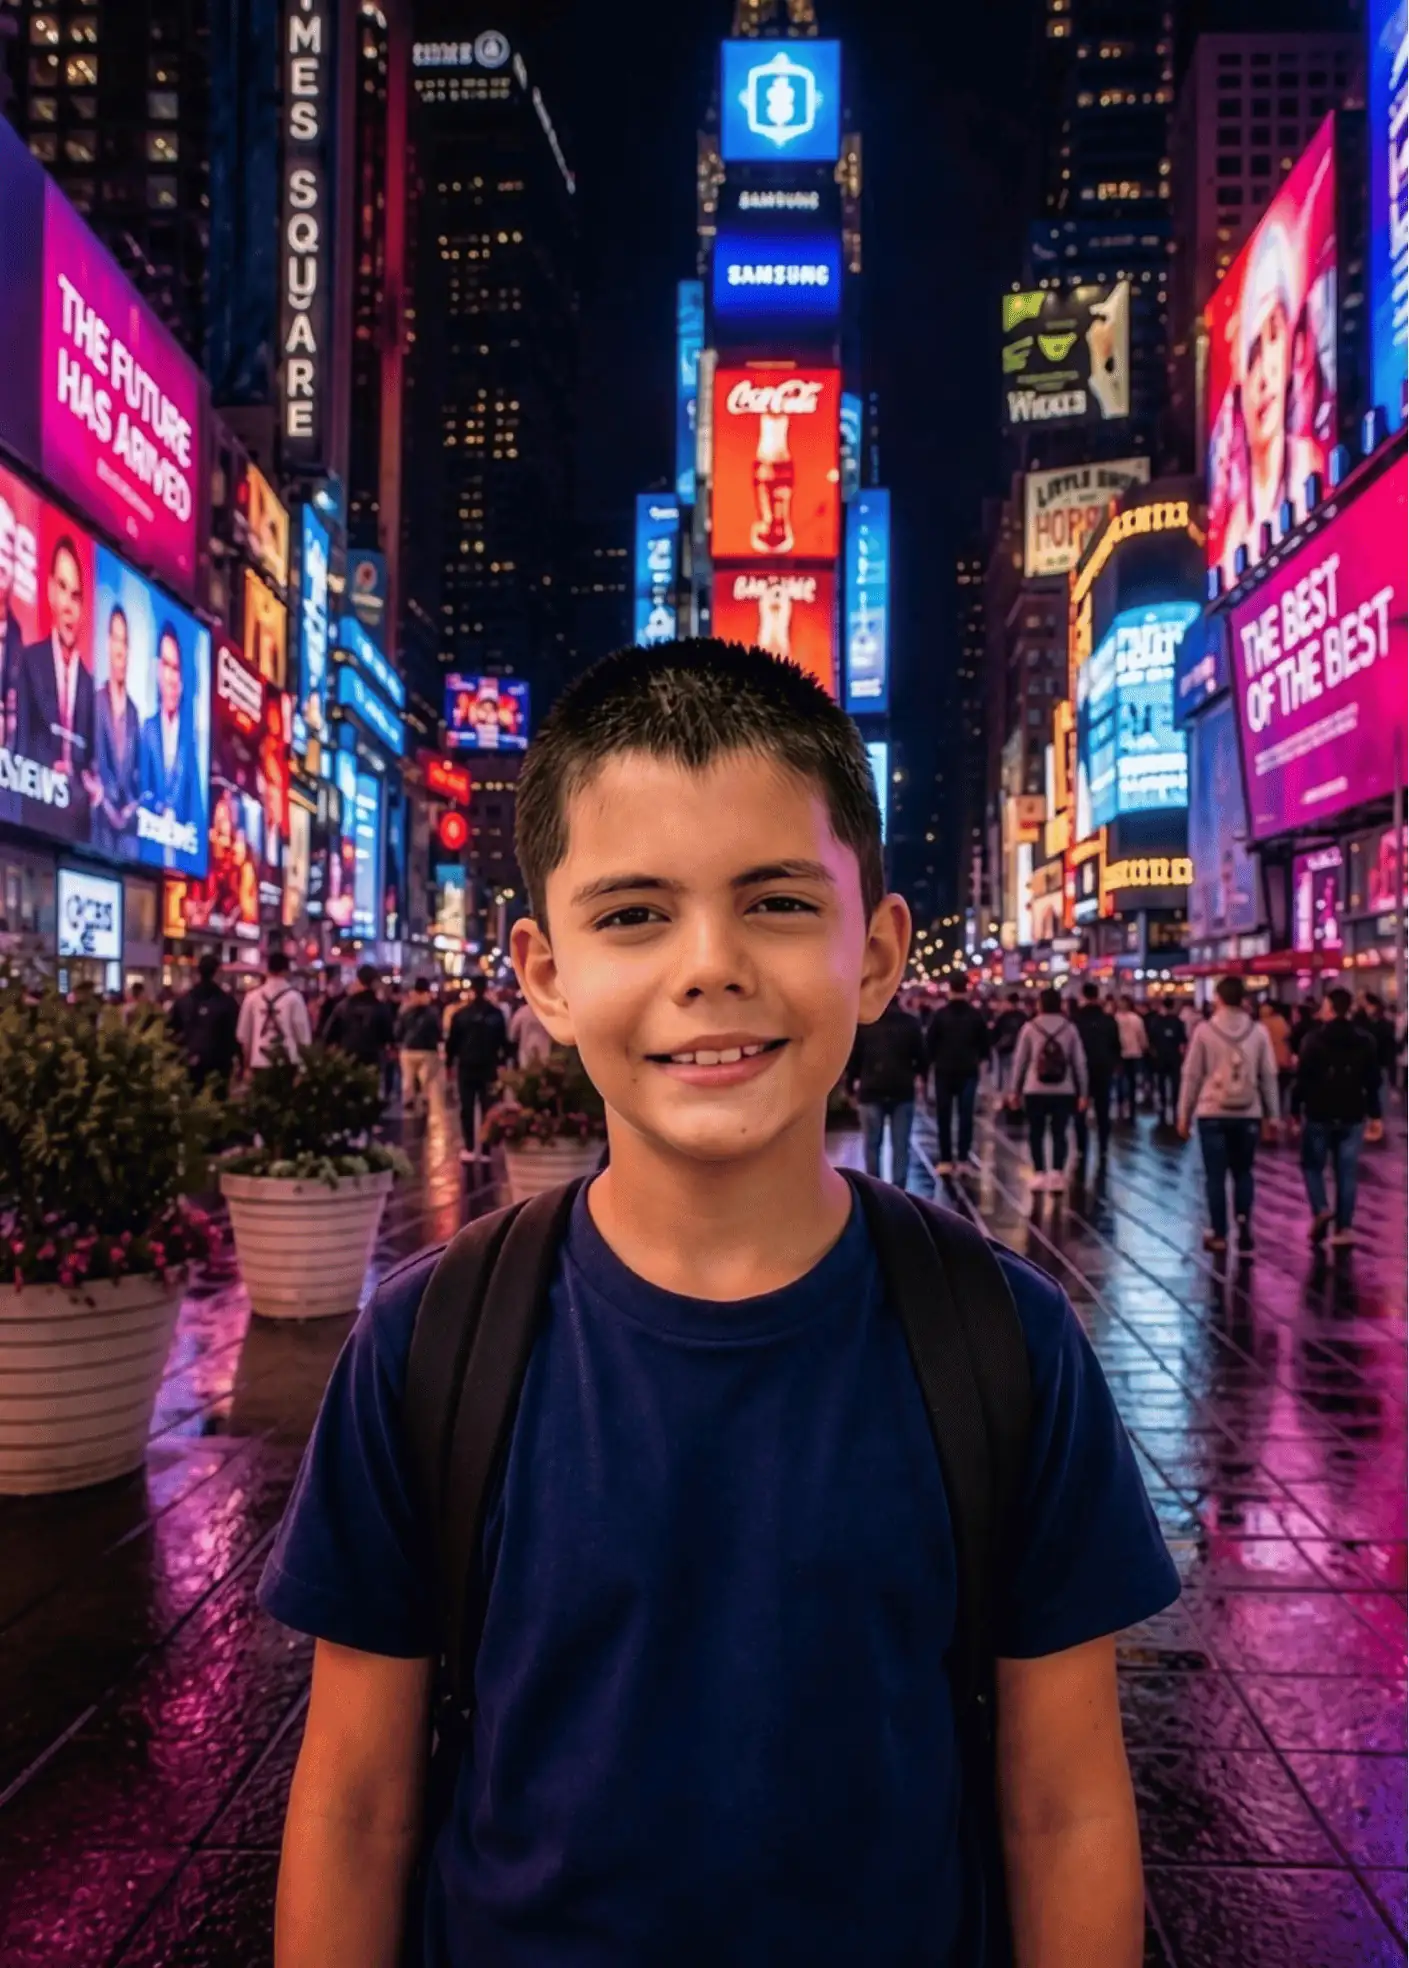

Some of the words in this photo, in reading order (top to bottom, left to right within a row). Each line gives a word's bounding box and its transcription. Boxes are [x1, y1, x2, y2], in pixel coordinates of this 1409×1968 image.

[286, 169, 319, 438] SQUARE
[727, 264, 829, 286] SAMSUNG
[57, 347, 112, 443] HAS
[58, 273, 110, 376] THE
[111, 338, 192, 468] FUTURE
[1240, 604, 1281, 679] THE
[1281, 552, 1340, 651] BEST
[1246, 670, 1276, 733] OF
[1275, 638, 1324, 716] THE
[1323, 585, 1394, 689] BEST
